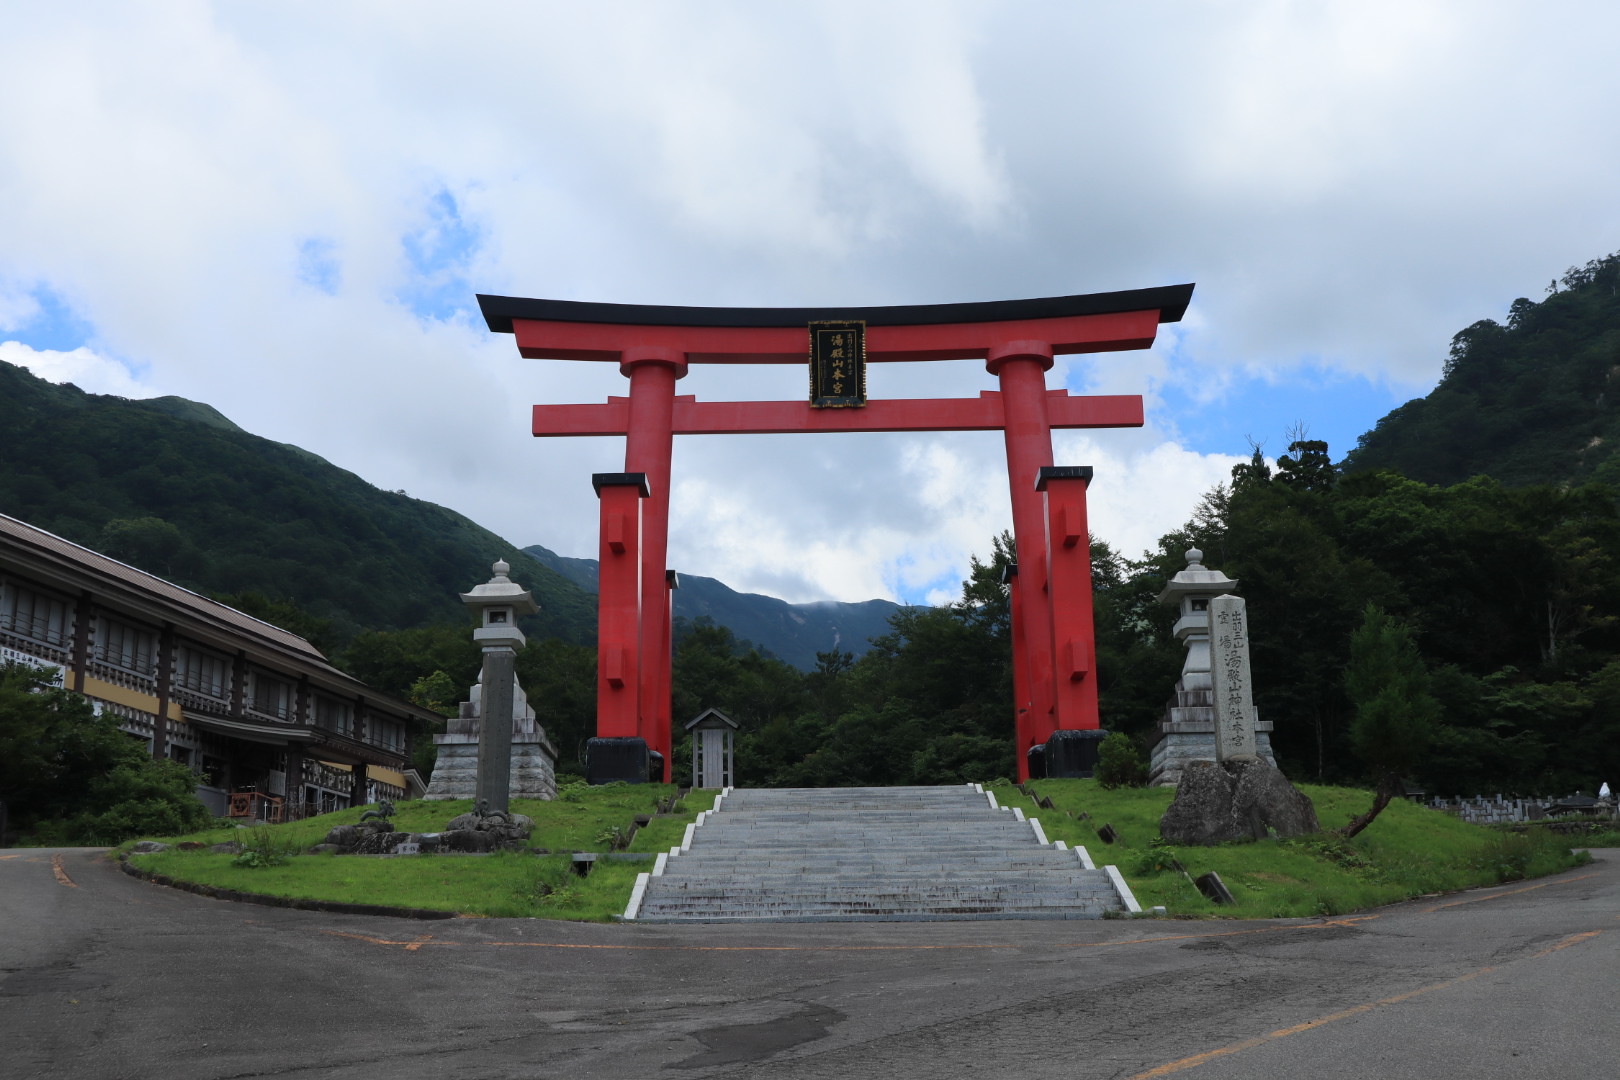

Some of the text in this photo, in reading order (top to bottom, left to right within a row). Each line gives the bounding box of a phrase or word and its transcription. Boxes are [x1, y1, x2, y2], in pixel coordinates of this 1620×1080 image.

[831, 334, 846, 394] 湯殿山本宮
[1231, 611, 1244, 649] 出羽三山
[1225, 650, 1244, 747] 湯殿山神社本宮
